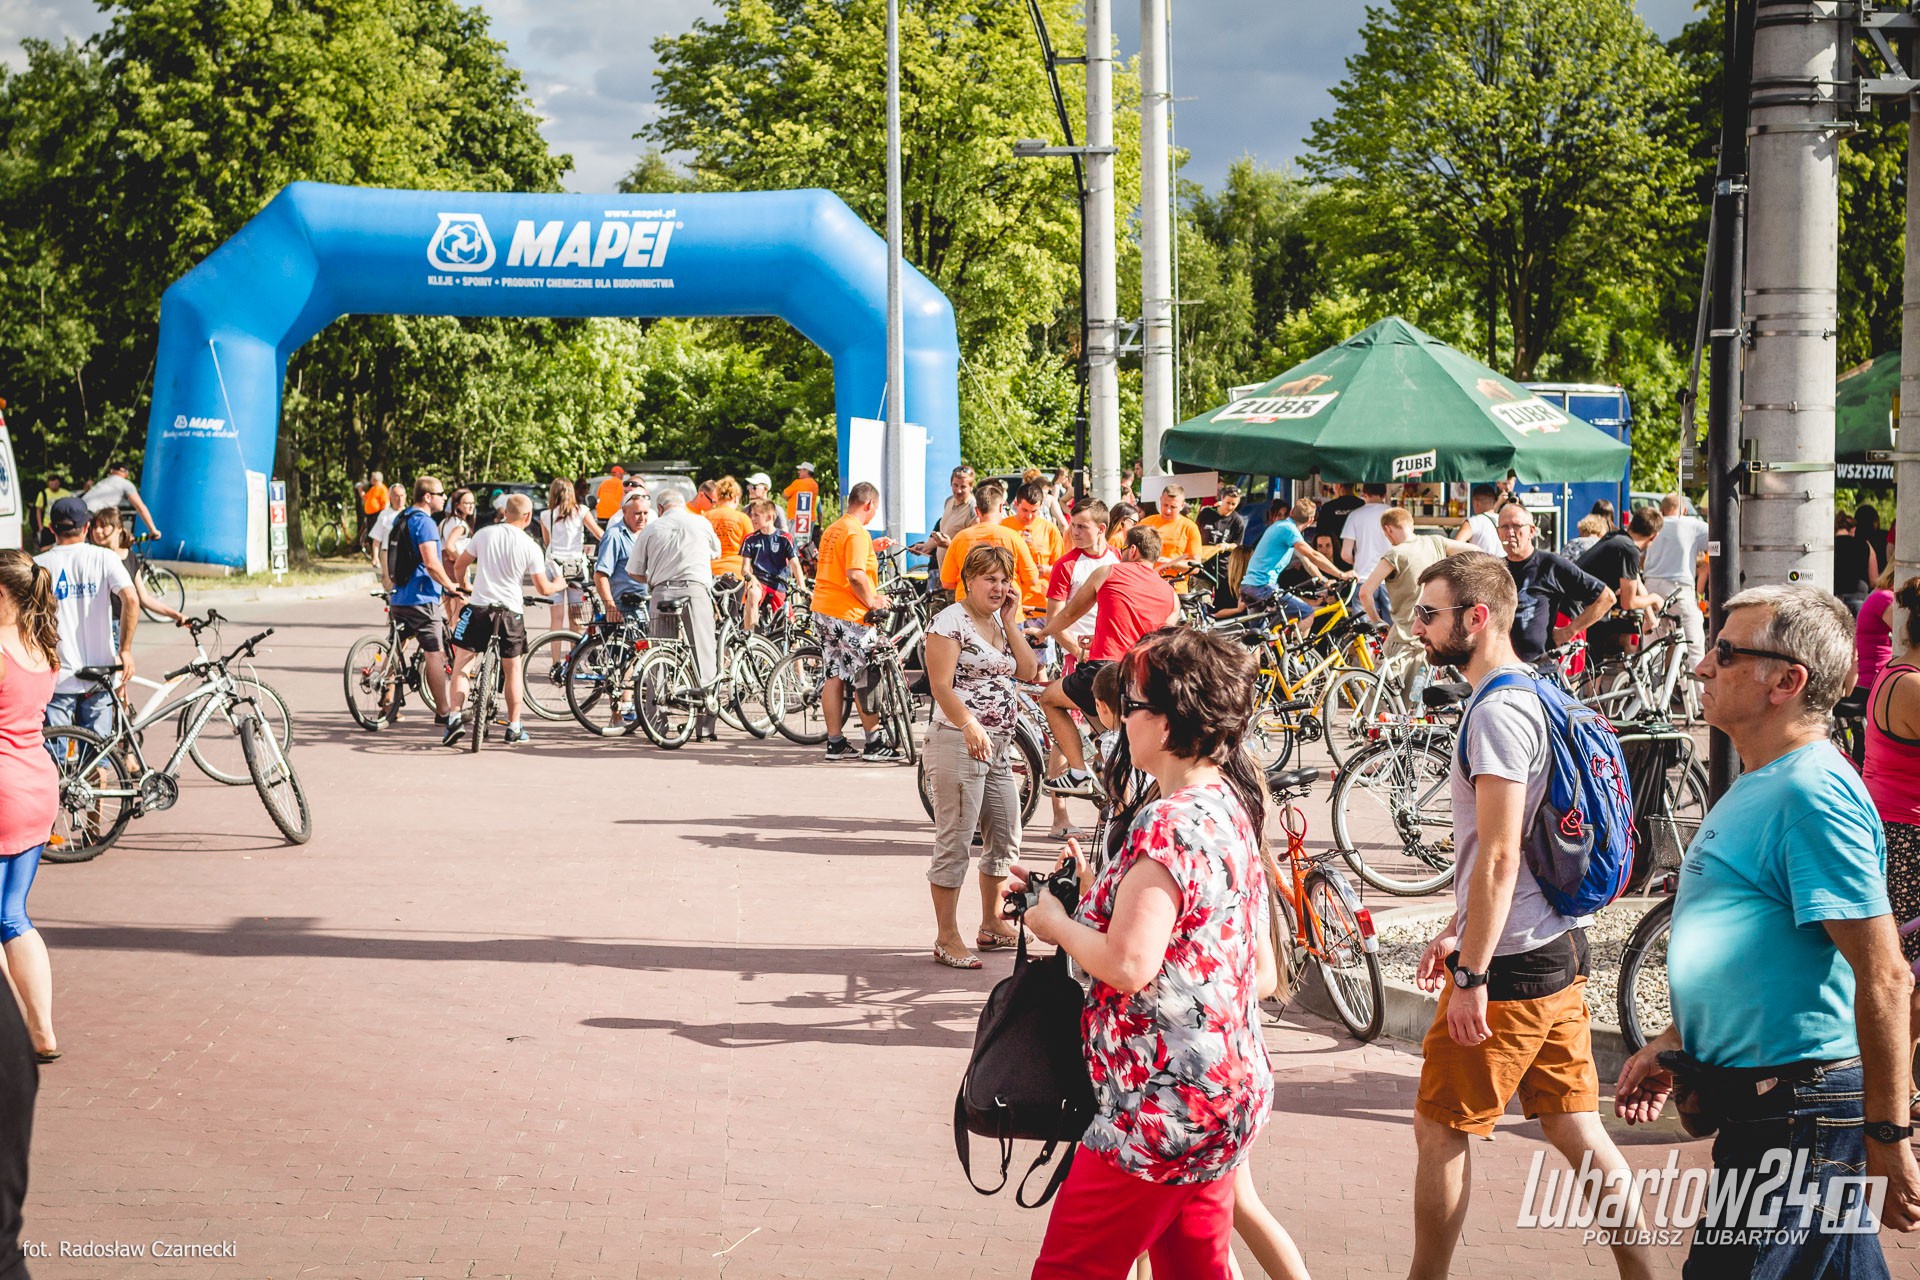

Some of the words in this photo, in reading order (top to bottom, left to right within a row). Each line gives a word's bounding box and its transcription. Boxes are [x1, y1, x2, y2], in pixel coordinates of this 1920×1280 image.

[604, 208, 676, 220] www.mapei.pl
[506, 220, 676, 267] MAPEI
[501, 277, 544, 288] PRODUKTY
[546, 278, 593, 289] CHEMICZNE
[595, 278, 611, 289] DLA
[613, 278, 675, 289] BUDOWNICTWA
[274, 486, 281, 500] 1
[800, 496, 807, 510] 1
[273, 507, 283, 522] 2
[797, 518, 807, 532] 2
[275, 554, 285, 569] 4
